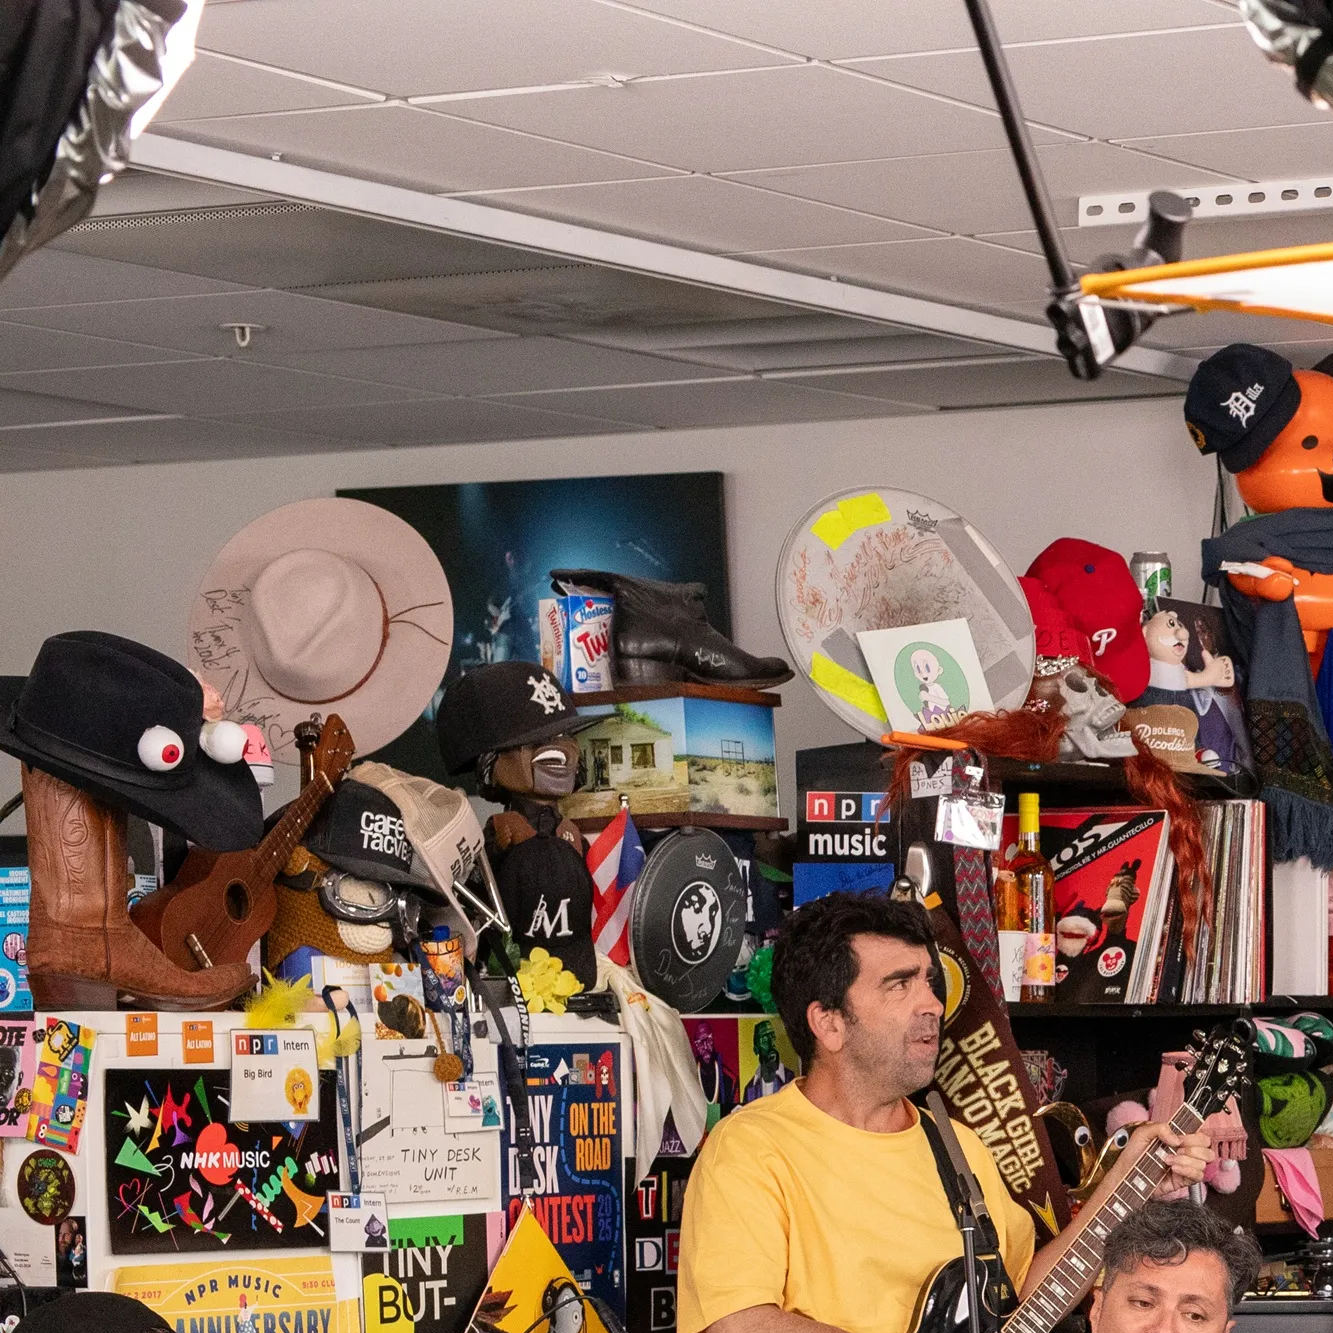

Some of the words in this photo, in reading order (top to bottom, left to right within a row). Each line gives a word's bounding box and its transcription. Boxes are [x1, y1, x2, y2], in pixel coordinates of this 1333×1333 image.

[580, 604, 612, 622] Hostess
[546, 606, 561, 657] Twinkies
[814, 797, 884, 819] npr
[809, 828, 887, 857] music
[529, 897, 574, 939] M
[507, 975, 531, 1046] MINUTOS
[238, 1036, 276, 1054] npr
[283, 1040, 310, 1051] Intern
[244, 1069, 256, 1080] Big
[257, 1069, 273, 1079] Bird
[960, 1021, 1024, 1118] BLACK
[1006, 1111, 1046, 1178] GIRL
[506, 1095, 553, 1144] TNY
[569, 1103, 589, 1136] ON
[591, 1102, 616, 1135] THE
[180, 1151, 222, 1169] NHK
[222, 1150, 270, 1169] MUSIC
[401, 1149, 438, 1163] TINY
[447, 1147, 482, 1162] DESK
[575, 1139, 611, 1172] ROAD
[659, 1140, 681, 1154] JAZZ
[976, 1118, 1033, 1194] MAGIC
[423, 1166, 458, 1181] UNIT
[508, 1145, 560, 1195] DSK
[333, 1196, 359, 1208] npr
[363, 1199, 382, 1207] Intern
[335, 1217, 346, 1225] The
[347, 1217, 361, 1225] Count
[509, 1195, 596, 1245] CNTEST
[382, 1235, 454, 1278] TINY
[143, 1290, 162, 1300] 2017
[184, 1278, 219, 1306] NPR
[228, 1274, 283, 1300] MUSIC
[302, 1280, 318, 1290] 9:30
[378, 1281, 456, 1325] BUT-
